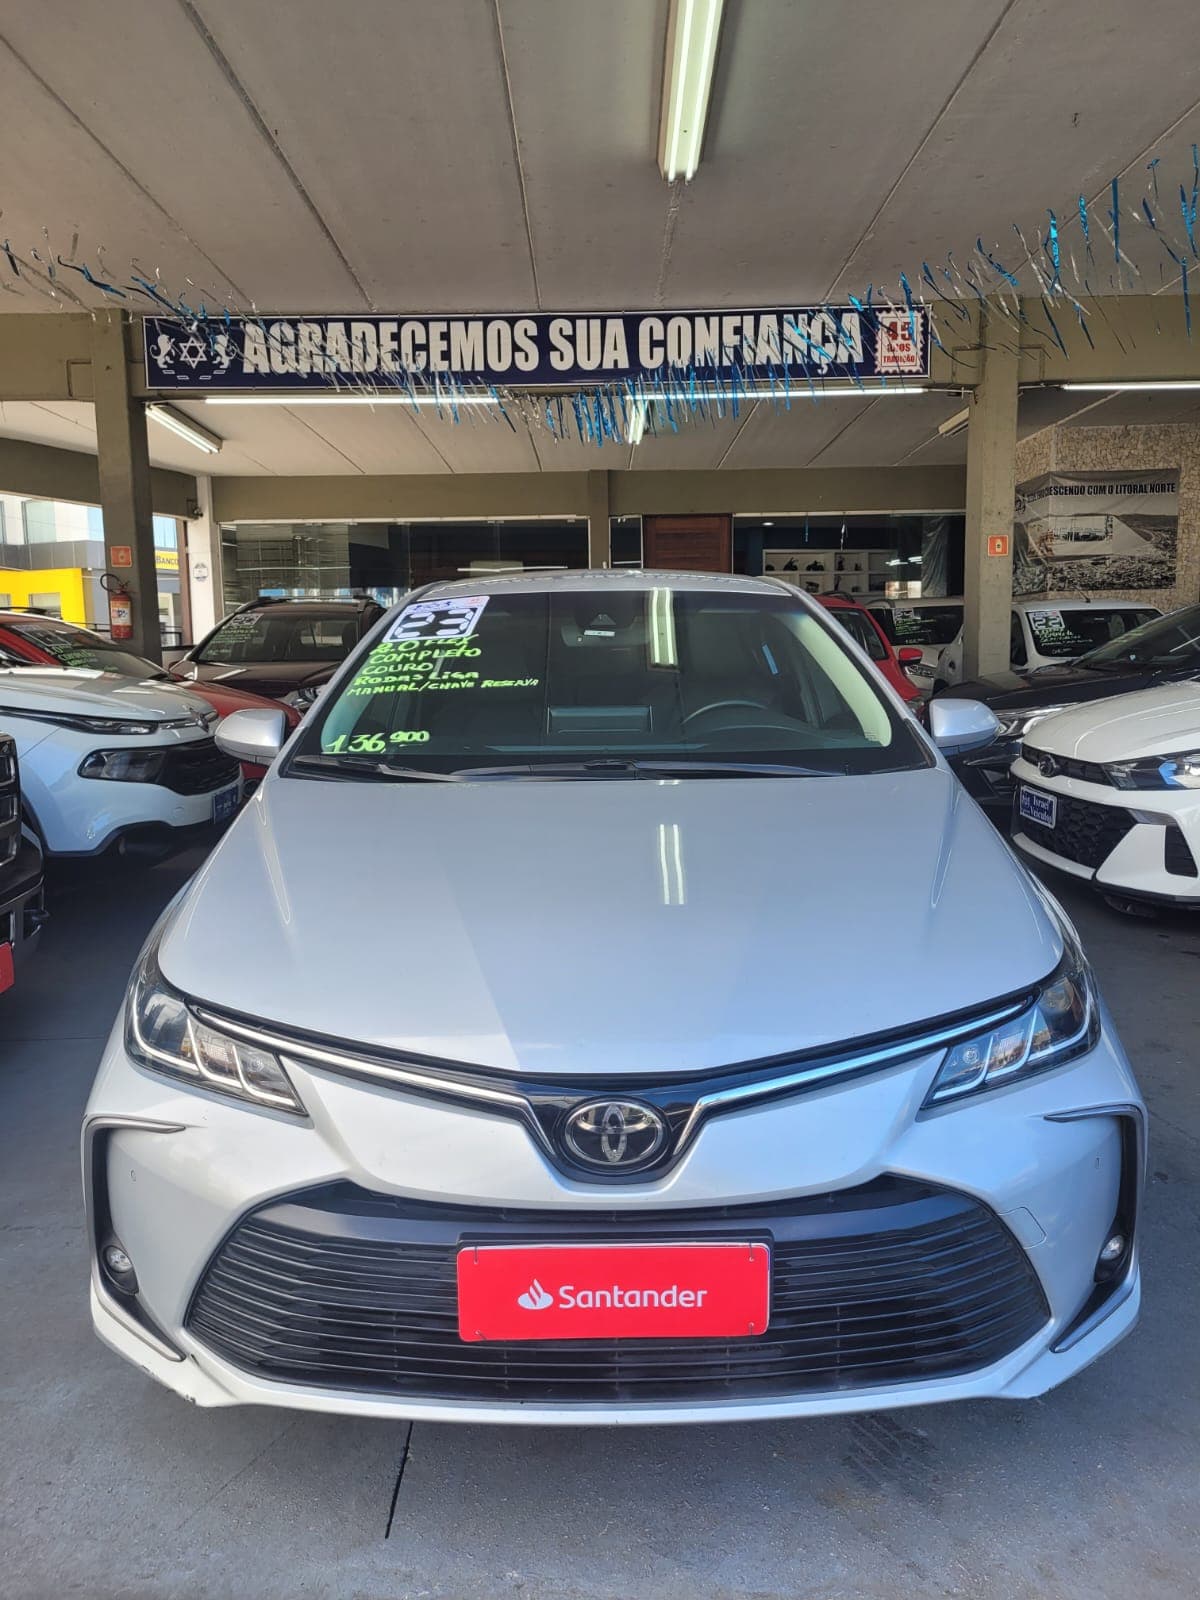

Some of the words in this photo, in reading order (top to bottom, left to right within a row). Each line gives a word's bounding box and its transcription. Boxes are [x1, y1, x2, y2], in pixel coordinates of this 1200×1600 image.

[243, 319, 539, 374] AGRADECEMOS
[548, 316, 629, 371] SUA
[638, 312, 865, 375] CONFIANÇA
[1087, 484, 1107, 496] COM
[1115, 483, 1148, 495] LITORAL
[1150, 482, 1177, 494] NORTE
[393, 606, 475, 639] 23
[369, 644, 482, 664] COMPLETO
[362, 662, 434, 676] COURO
[558, 1284, 708, 1309] Santander
